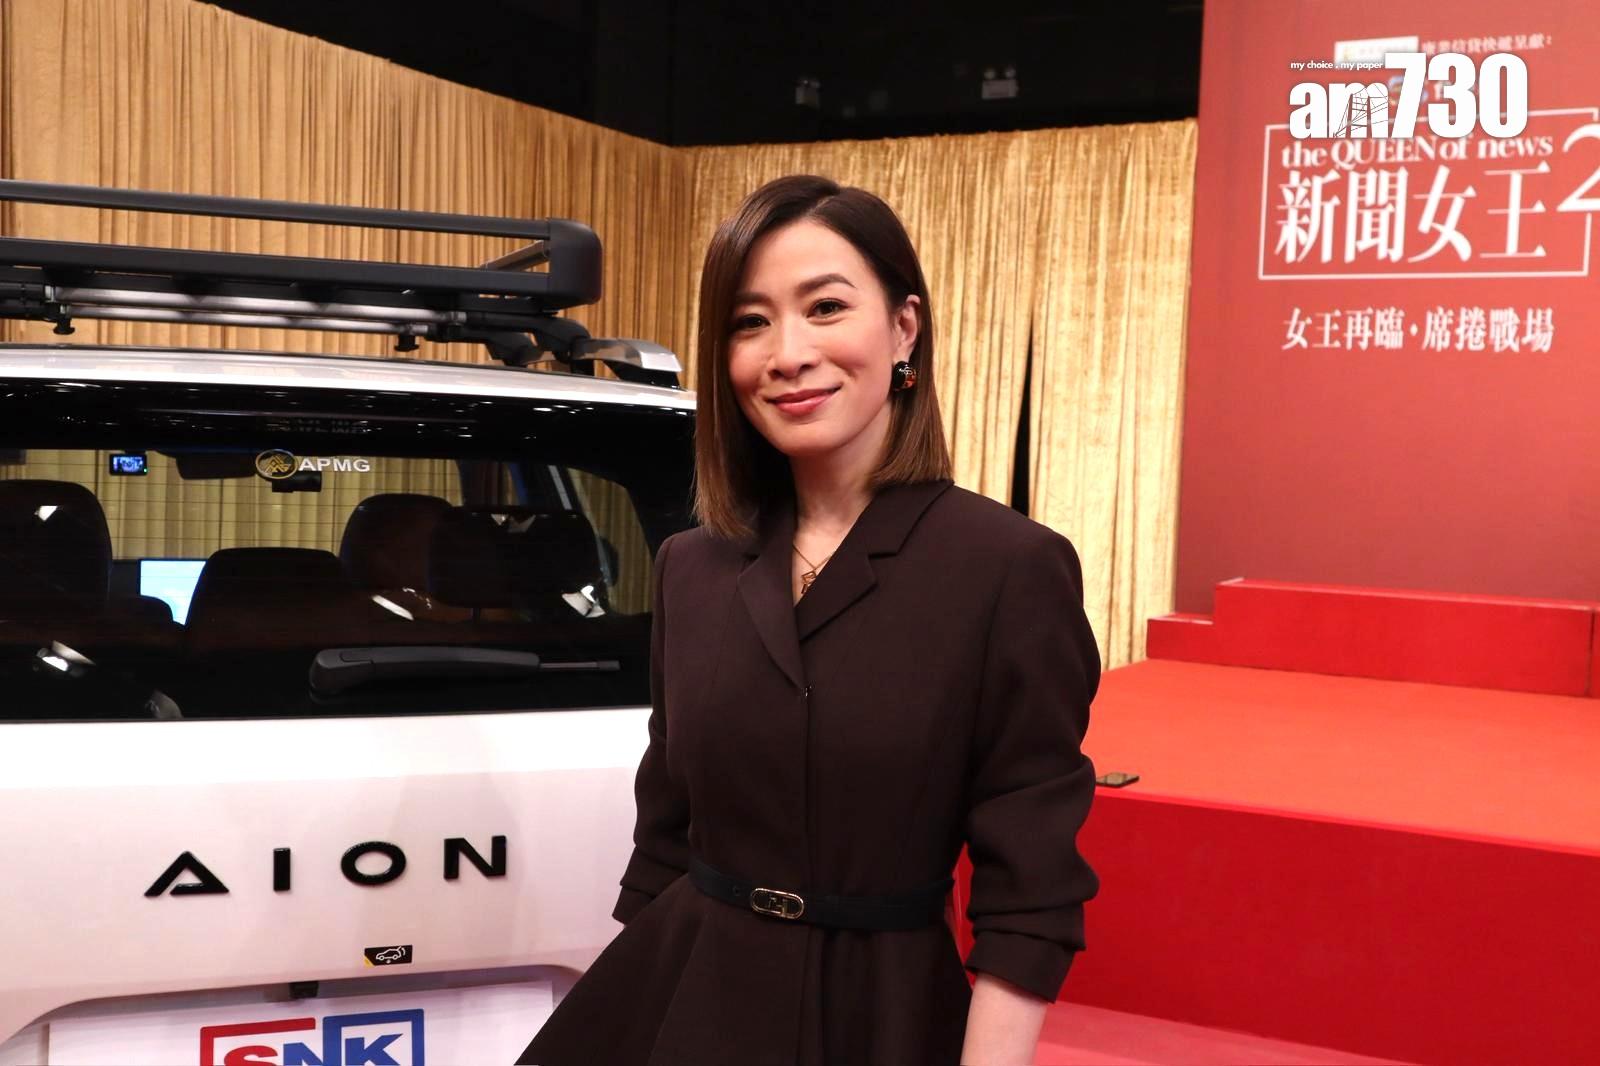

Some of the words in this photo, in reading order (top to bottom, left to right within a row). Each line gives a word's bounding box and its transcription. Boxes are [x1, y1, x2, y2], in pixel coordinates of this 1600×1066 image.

[1282, 140, 1327, 168] the
[1331, 134, 1437, 170] QUEEN
[1439, 137, 1468, 159] of
[1477, 136, 1553, 159] news
[1275, 160, 1551, 263] 新聞女王
[298, 458, 370, 472] APMG
[144, 835, 507, 897] AION
